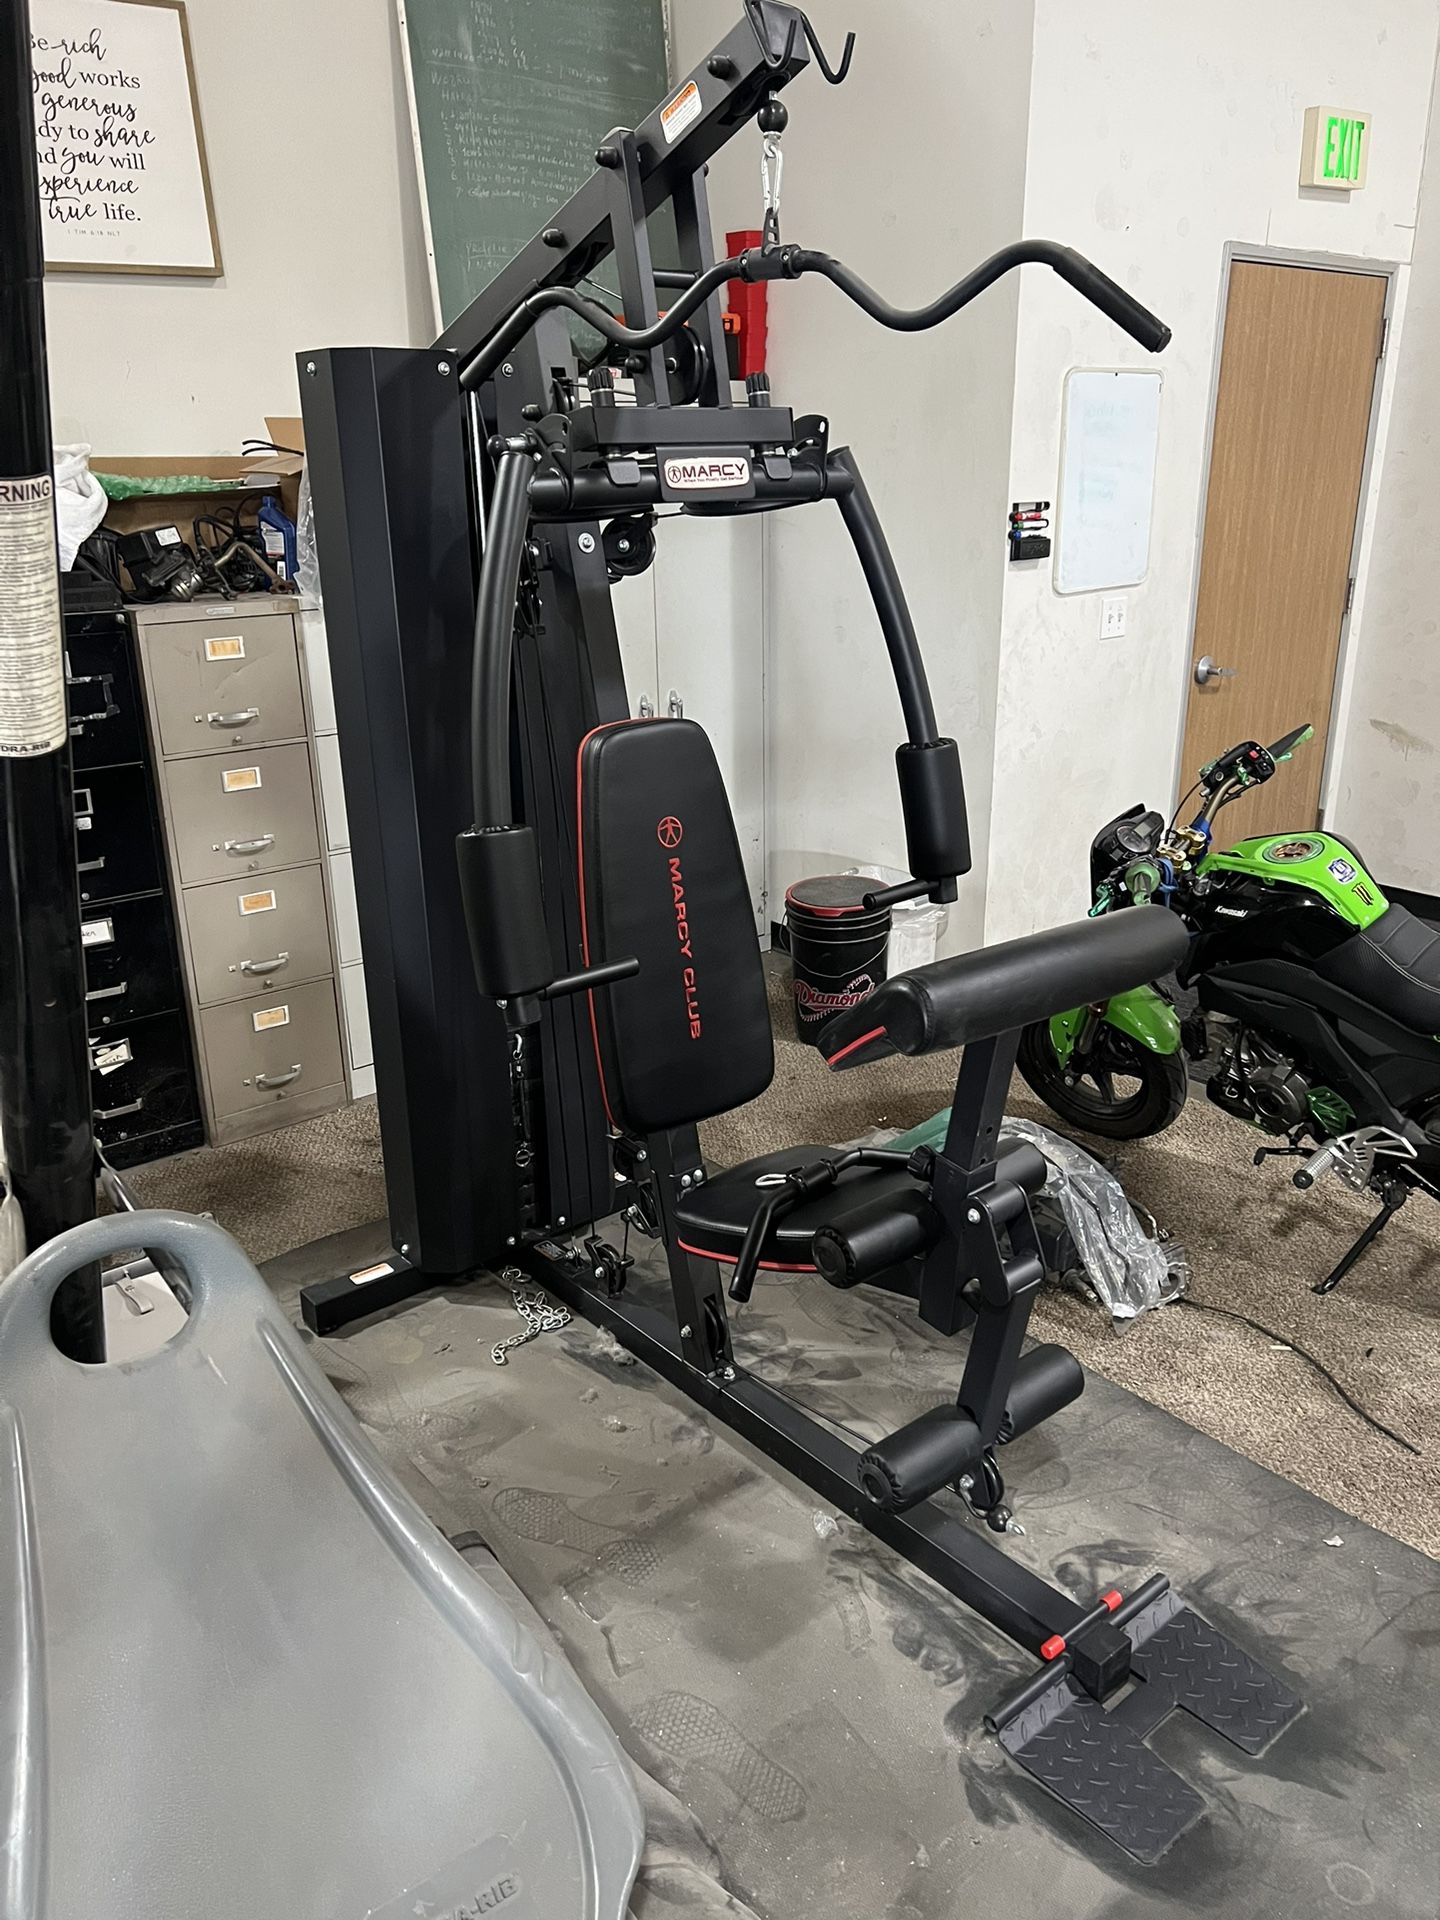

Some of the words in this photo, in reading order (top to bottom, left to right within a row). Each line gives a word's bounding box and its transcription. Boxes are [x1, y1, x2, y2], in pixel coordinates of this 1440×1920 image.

[51, 28, 107, 61] rich
[79, 69, 141, 89] works
[41, 92, 137, 122] generous
[68, 124, 89, 140] to
[93, 115, 156, 147] share
[60, 147, 105, 174] you
[109, 152, 146, 171] will
[1322, 116, 1365, 180] EXIT
[102, 202, 142, 222] life.
[682, 464, 745, 477] MARCY
[1215, 905, 1248, 917] Kawasaki
[668, 857, 693, 959] MARCY
[683, 967, 701, 1039] CLUB
